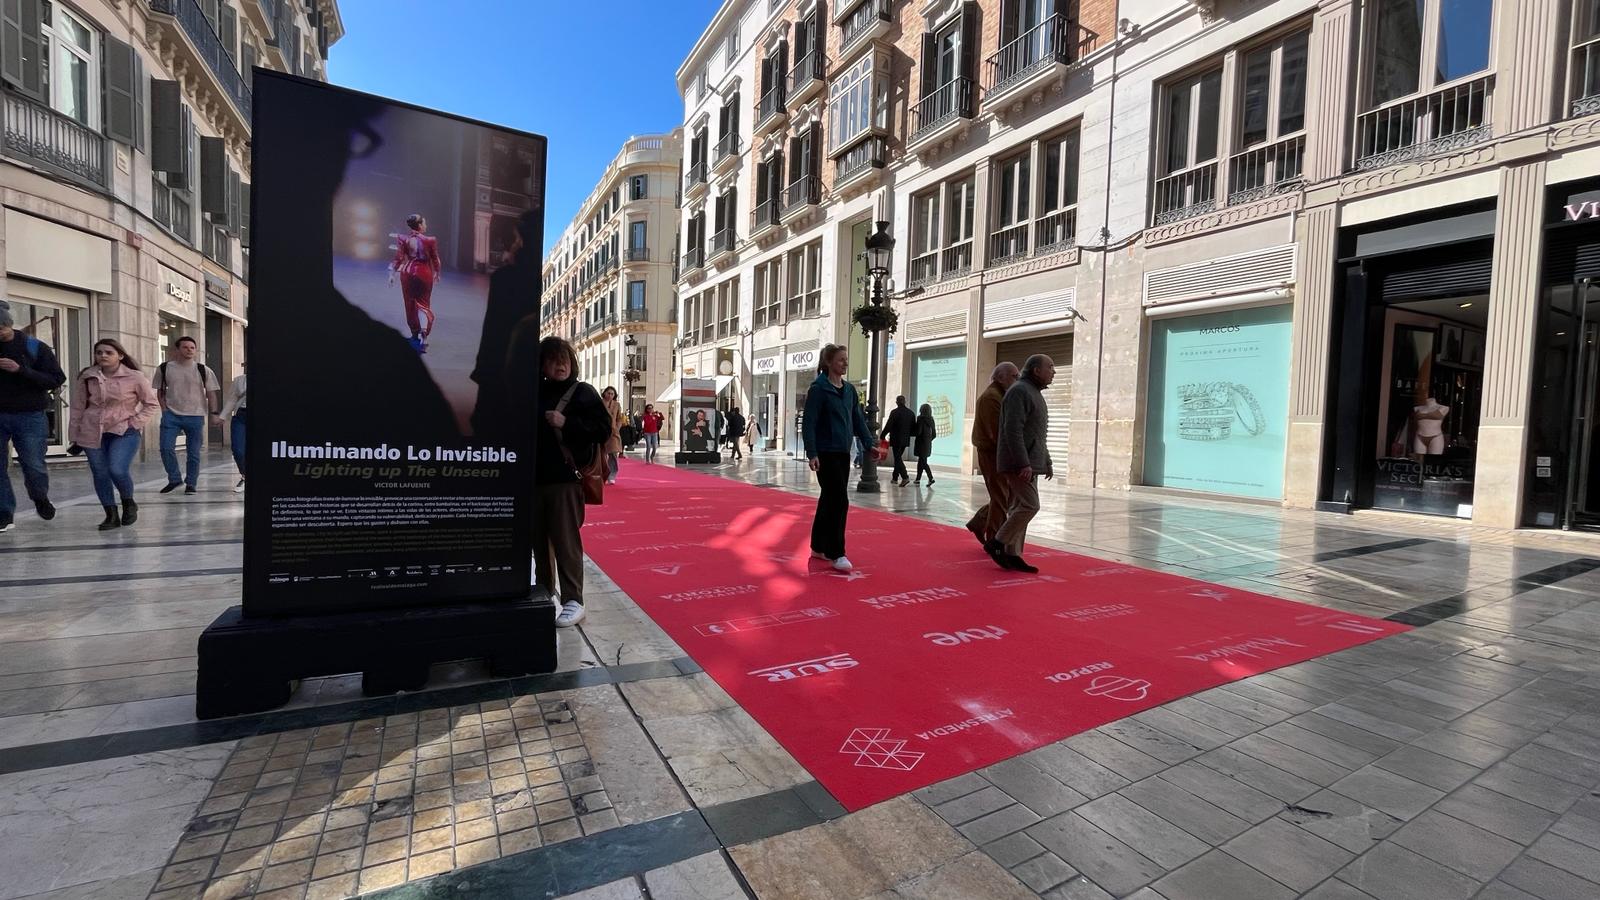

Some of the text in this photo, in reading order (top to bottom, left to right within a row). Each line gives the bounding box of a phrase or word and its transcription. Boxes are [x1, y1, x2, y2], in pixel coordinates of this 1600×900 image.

[1199, 324, 1241, 336] MARCOS
[757, 358, 775, 369] KIKO
[792, 352, 814, 365] KIKO
[272, 441, 517, 463] Iluminando Lo Invisible
[293, 463, 500, 480] Lighting up The Unseen
[923, 624, 1010, 646] rtve
[757, 657, 860, 682] SUR
[1044, 661, 1117, 683] REPSOL
[914, 708, 1018, 741] ATRESMEDIA
